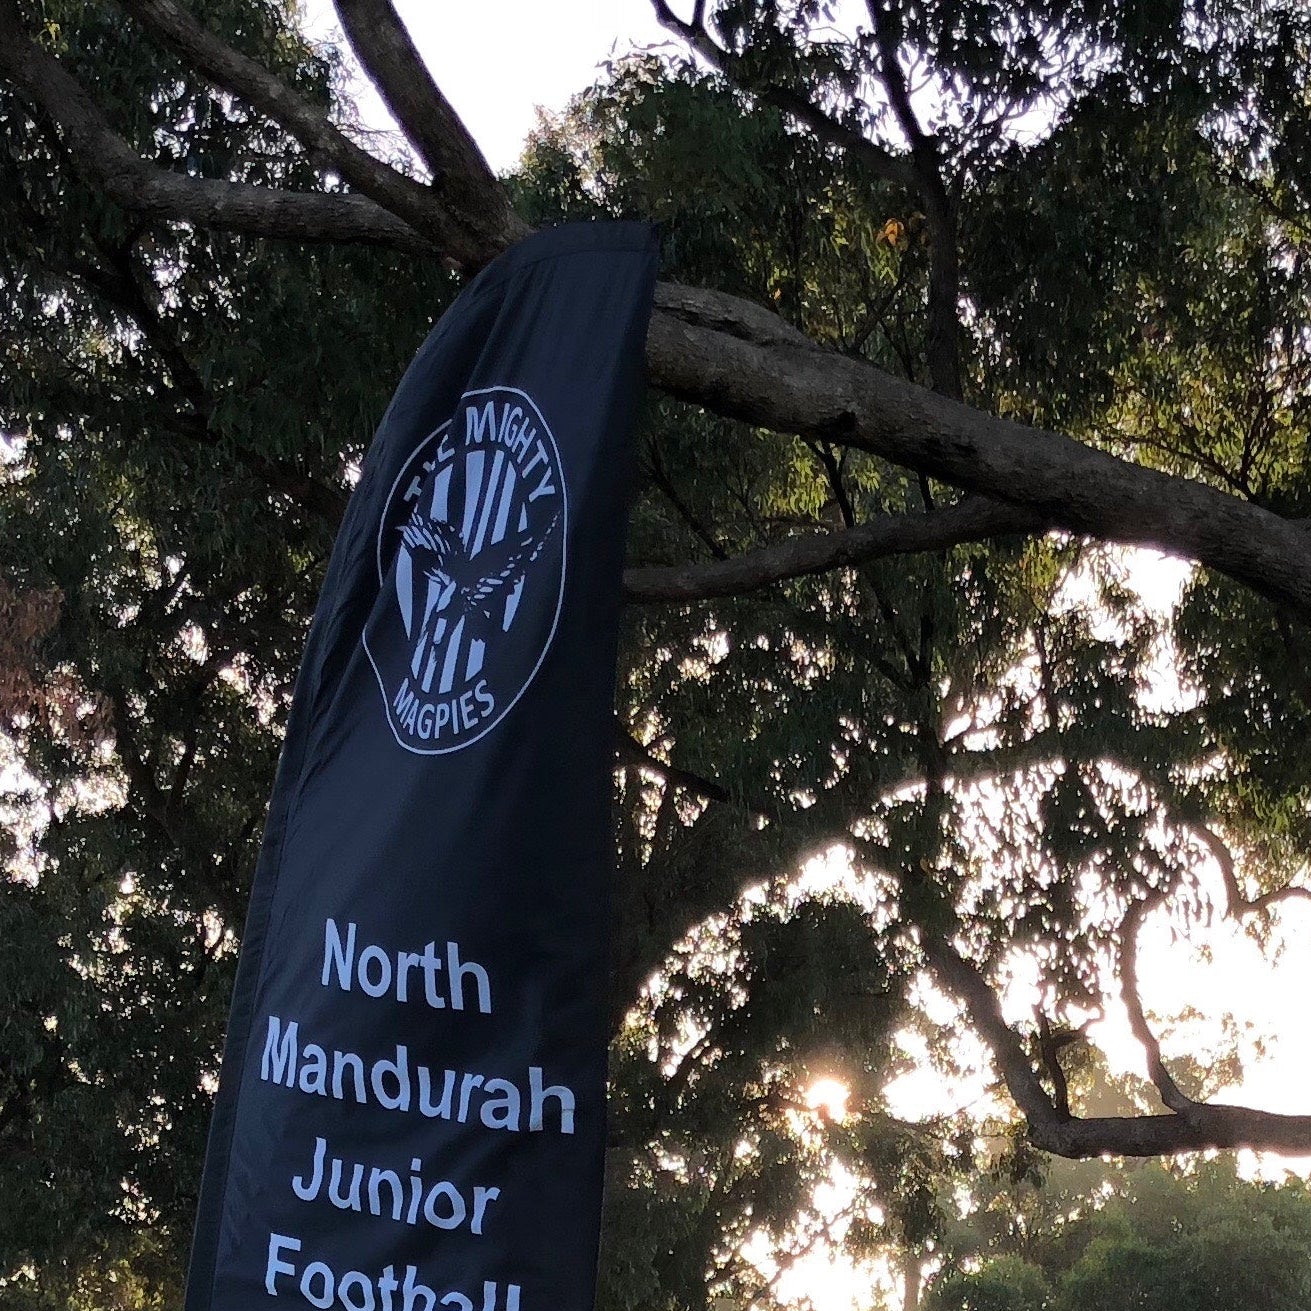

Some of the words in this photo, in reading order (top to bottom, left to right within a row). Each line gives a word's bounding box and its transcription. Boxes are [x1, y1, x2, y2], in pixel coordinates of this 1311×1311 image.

[464, 400, 556, 503] MIGHTY
[392, 677, 495, 740] MAGPIES
[321, 917, 492, 1014] North
[260, 1015, 576, 1134] Mandurah
[291, 1136, 501, 1235] Junior
